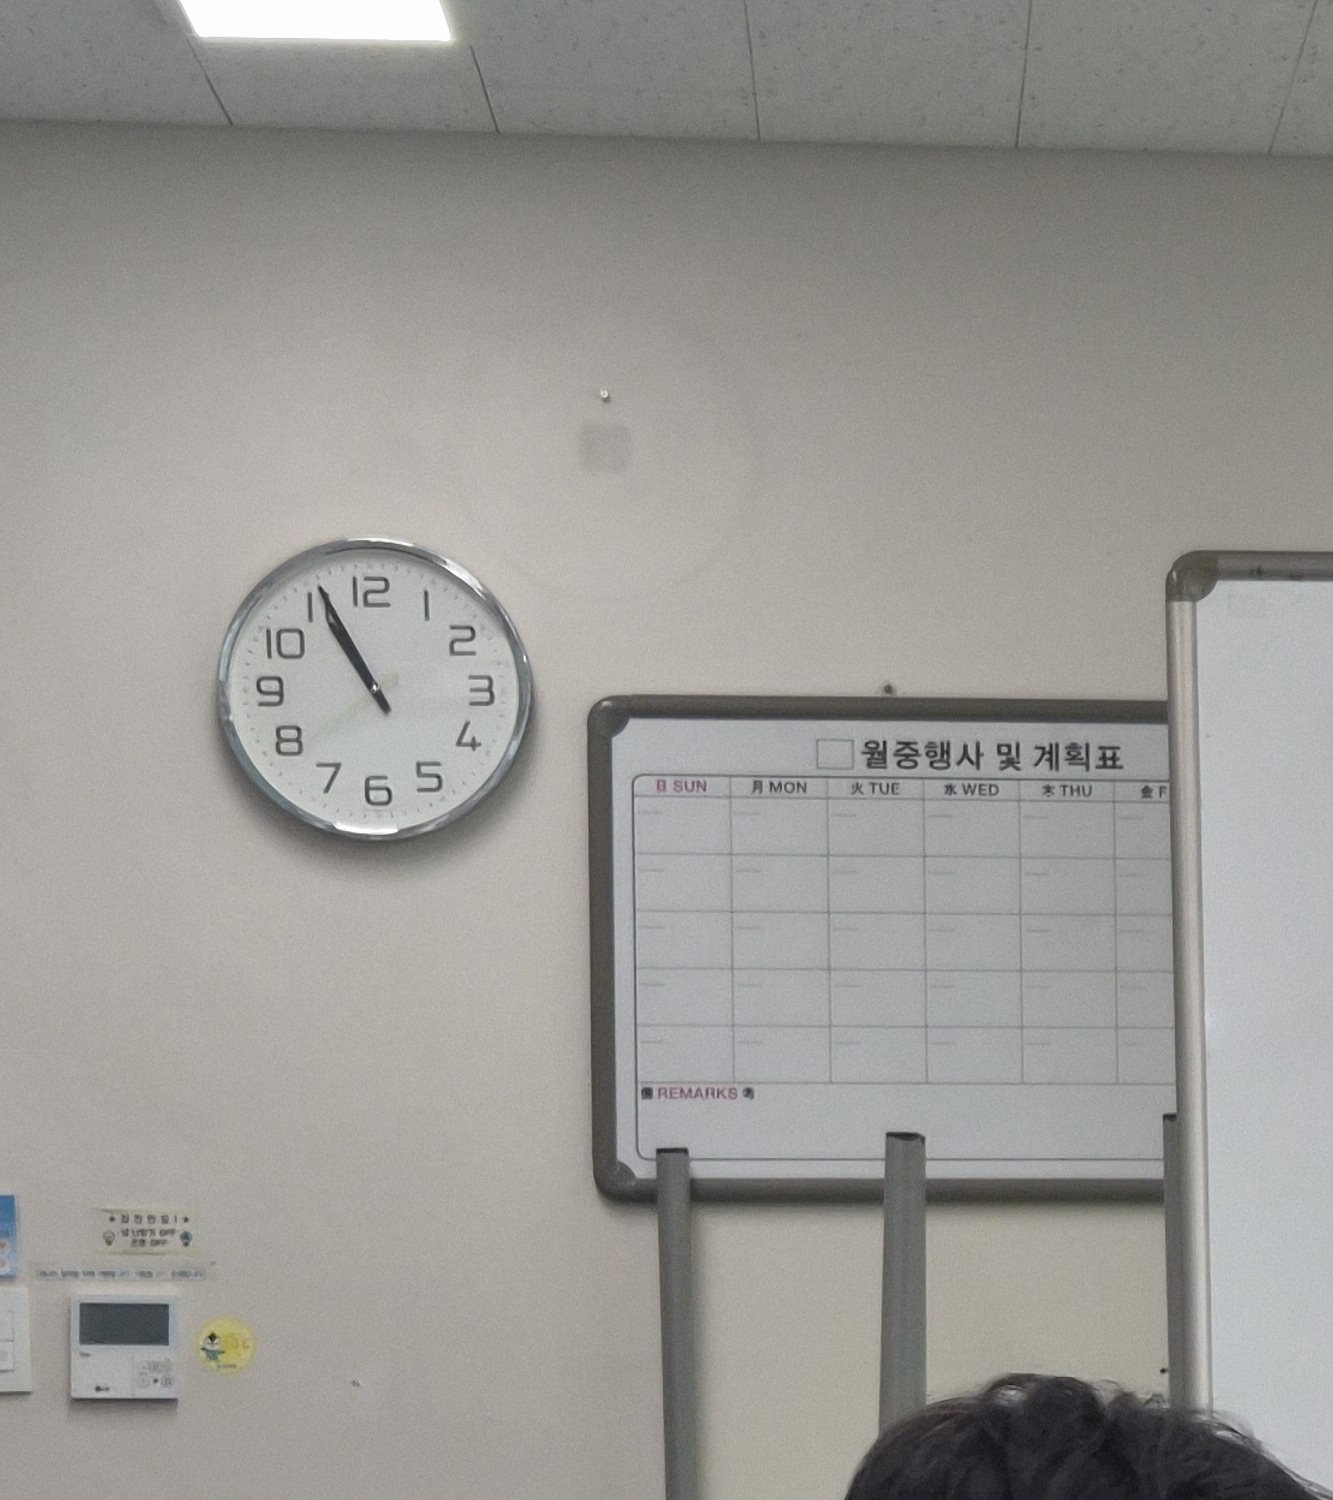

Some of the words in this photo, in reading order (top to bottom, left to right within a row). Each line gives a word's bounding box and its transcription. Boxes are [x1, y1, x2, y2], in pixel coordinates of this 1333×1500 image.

[352, 575, 391, 608] 12
[423, 589, 430, 621] 1
[265, 627, 306, 660] 10
[449, 624, 477, 656] 2
[256, 675, 284, 707] 9
[467, 674, 495, 706] 3
[275, 724, 304, 757] 8
[455, 720, 482, 751] 4
[860, 740, 985, 770] 월중행사
[996, 741, 1022, 771] 및
[1032, 742, 1125, 772] 계획표
[315, 762, 342, 794] 7
[364, 775, 393, 806] 6
[416, 761, 443, 793] 5
[673, 780, 707, 793] SUN
[769, 781, 808, 794] MON
[869, 782, 901, 796] TUE
[961, 784, 1000, 797] WED
[1060, 785, 1093, 798] THU
[657, 1087, 738, 1100] REMARKS
